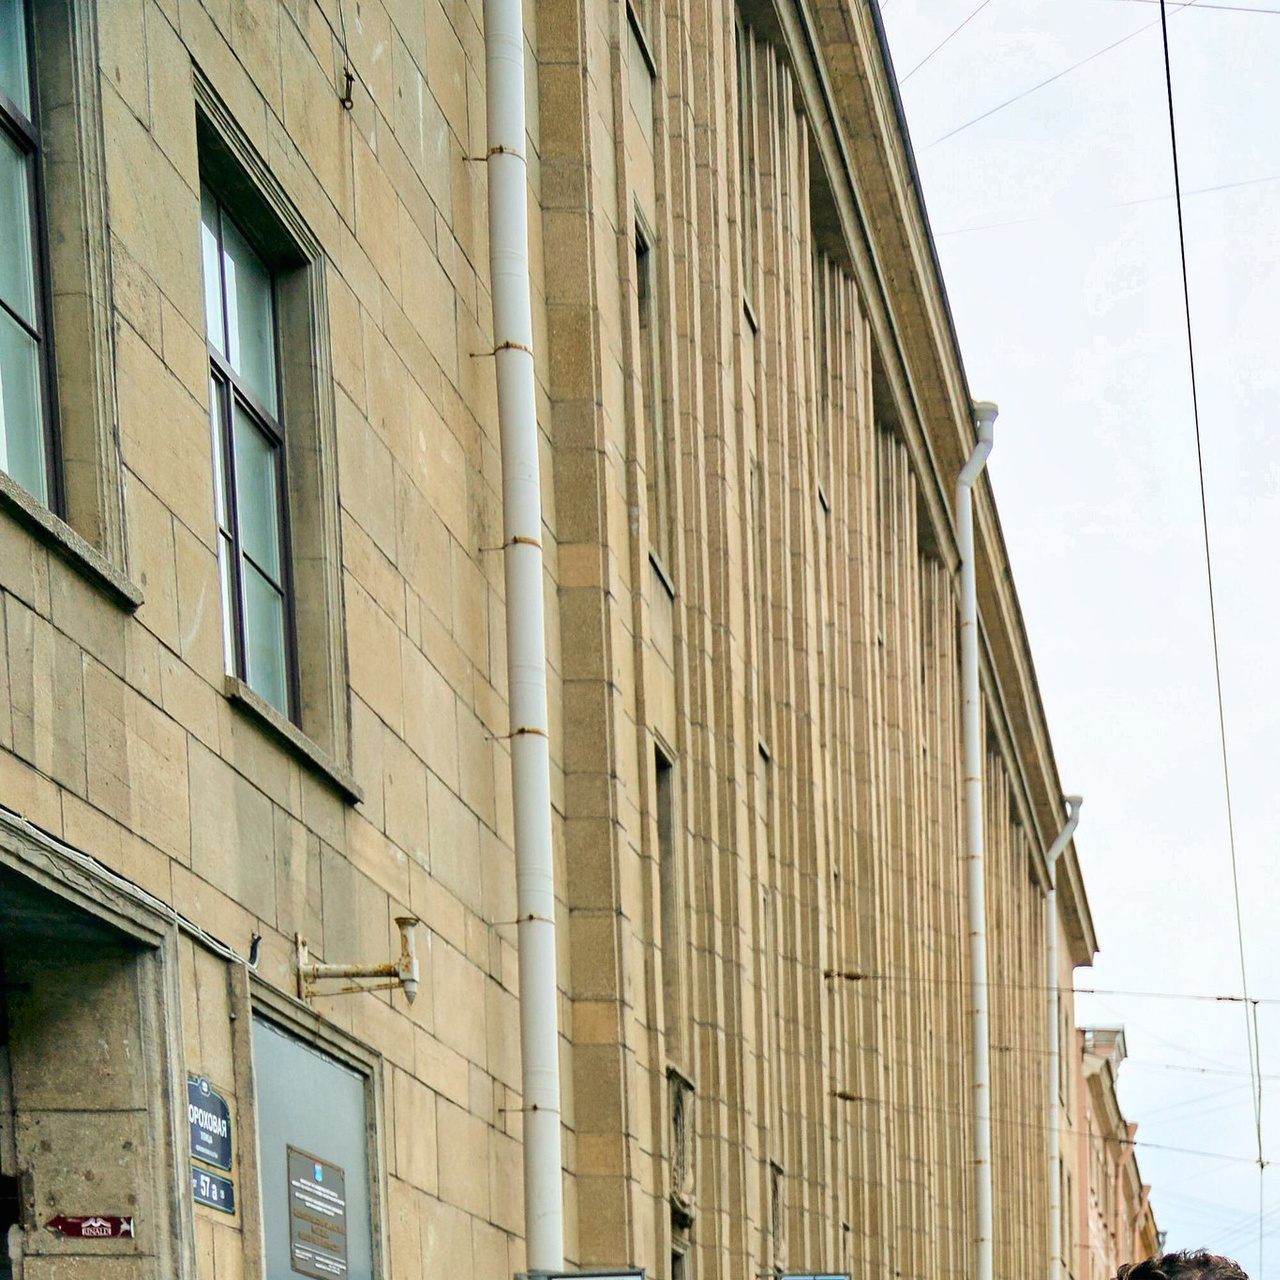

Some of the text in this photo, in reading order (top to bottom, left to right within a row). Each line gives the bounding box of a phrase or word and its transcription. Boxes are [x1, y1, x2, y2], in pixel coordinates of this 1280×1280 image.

[188, 1104, 227, 1138] ОРОХОВАЯ
[200, 1174, 210, 1198] 57
[82, 1227, 112, 1236] RINALDI
